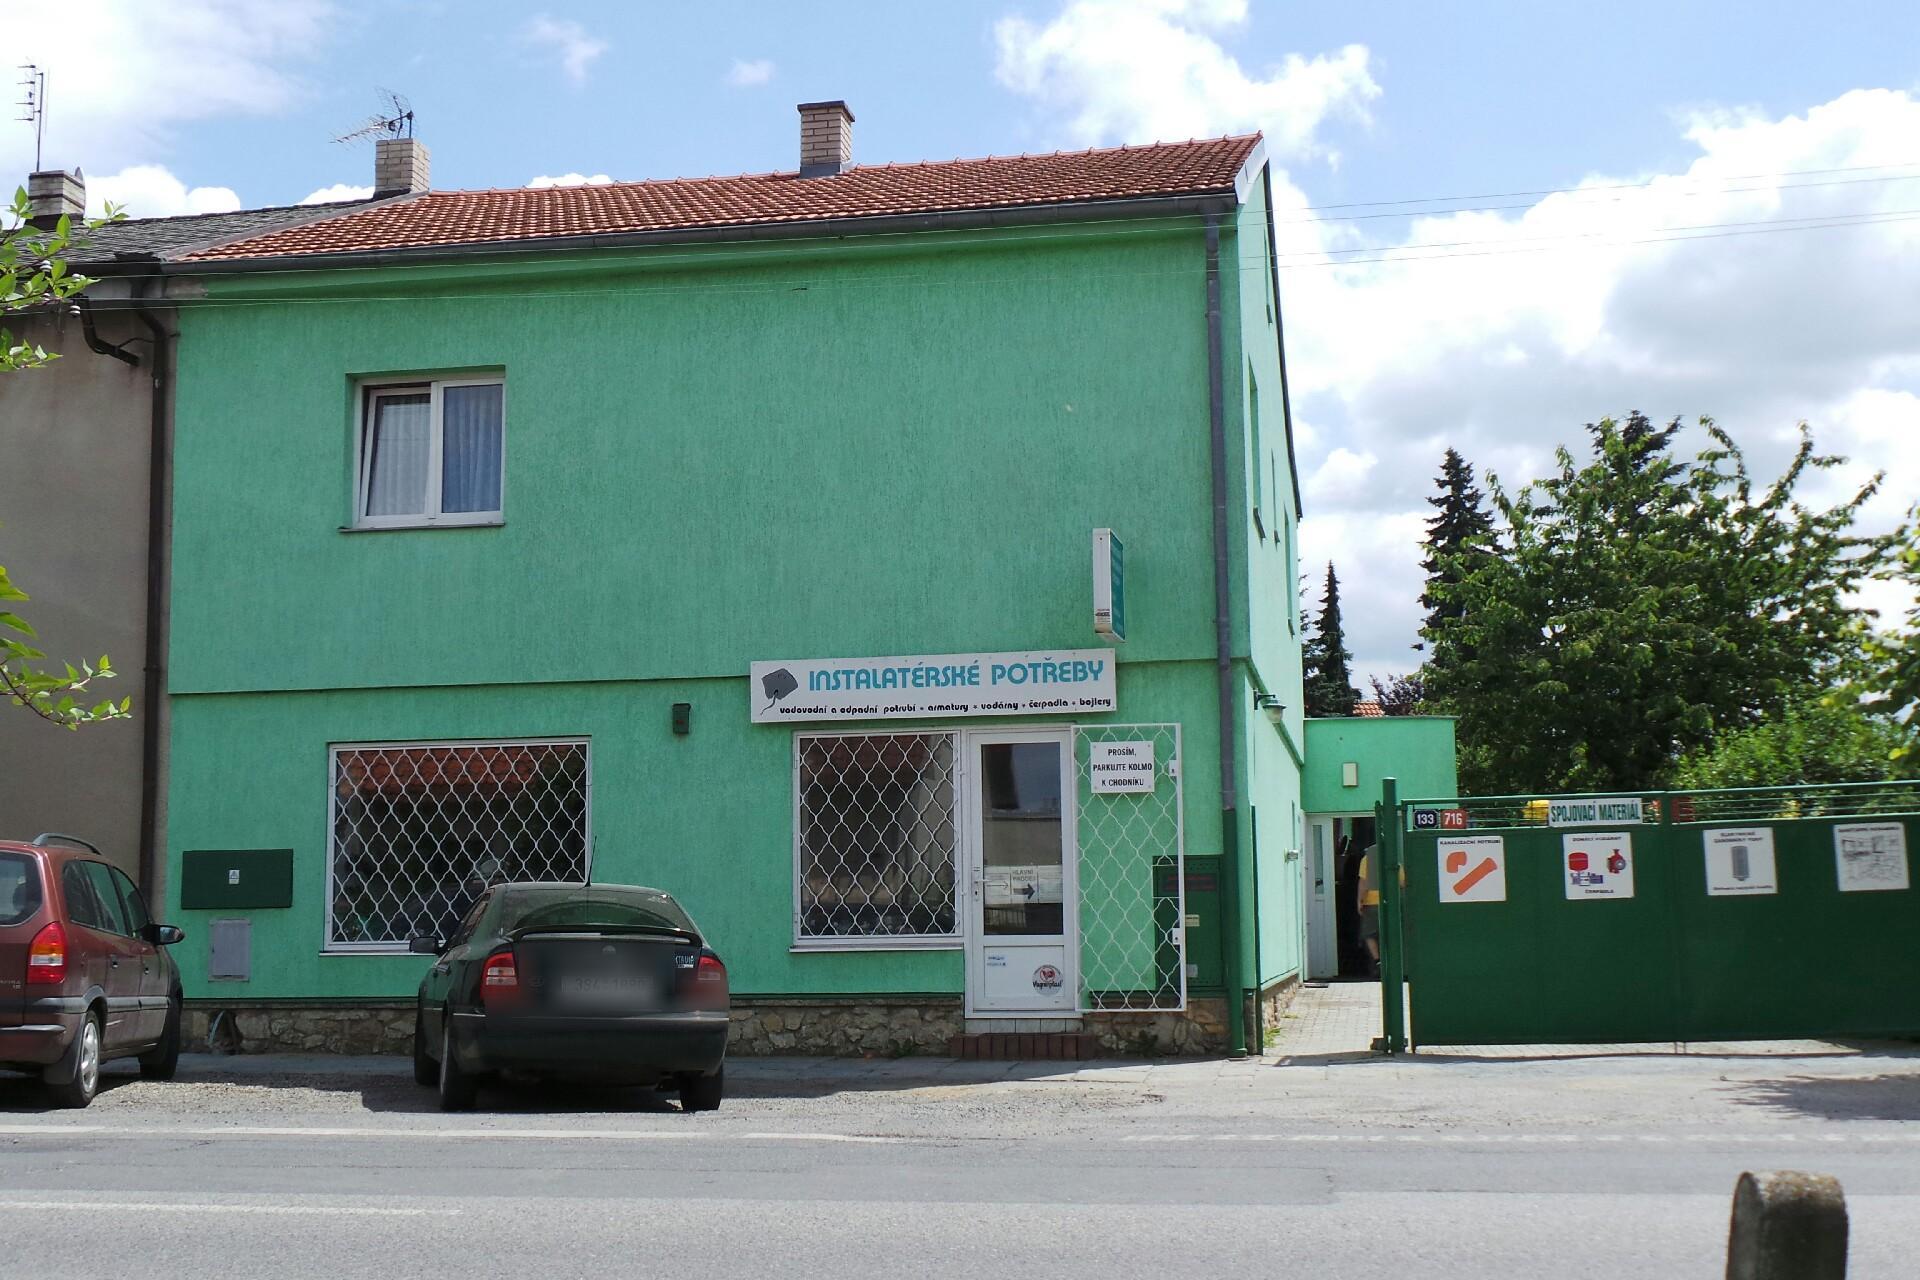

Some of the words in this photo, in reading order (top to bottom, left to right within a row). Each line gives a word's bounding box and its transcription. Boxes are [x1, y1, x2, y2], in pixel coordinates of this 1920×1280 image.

[809, 660, 980, 691] INSTALATÉRSKÉ
[991, 656, 1104, 685] POTŘEBY
[779, 705, 828, 714] vodovodní
[831, 706, 837, 714] a
[840, 704, 878, 715] odpadní
[883, 703, 916, 714] potrubí
[927, 703, 969, 712] armatury
[981, 700, 1019, 711] vodárny
[1029, 698, 1069, 708] čerpadla
[1079, 697, 1111, 708] bojlery
[1108, 747, 1137, 757] PROSÍM,
[1093, 763, 1126, 771] PARKUJTE
[1108, 777, 1144, 786] CHODNÍKU
[1550, 801, 1597, 822] SPOJOVACÍ
[1598, 800, 1641, 821] MATERIÁL
[1417, 813, 1435, 825] 133
[1444, 812, 1463, 825] 716
